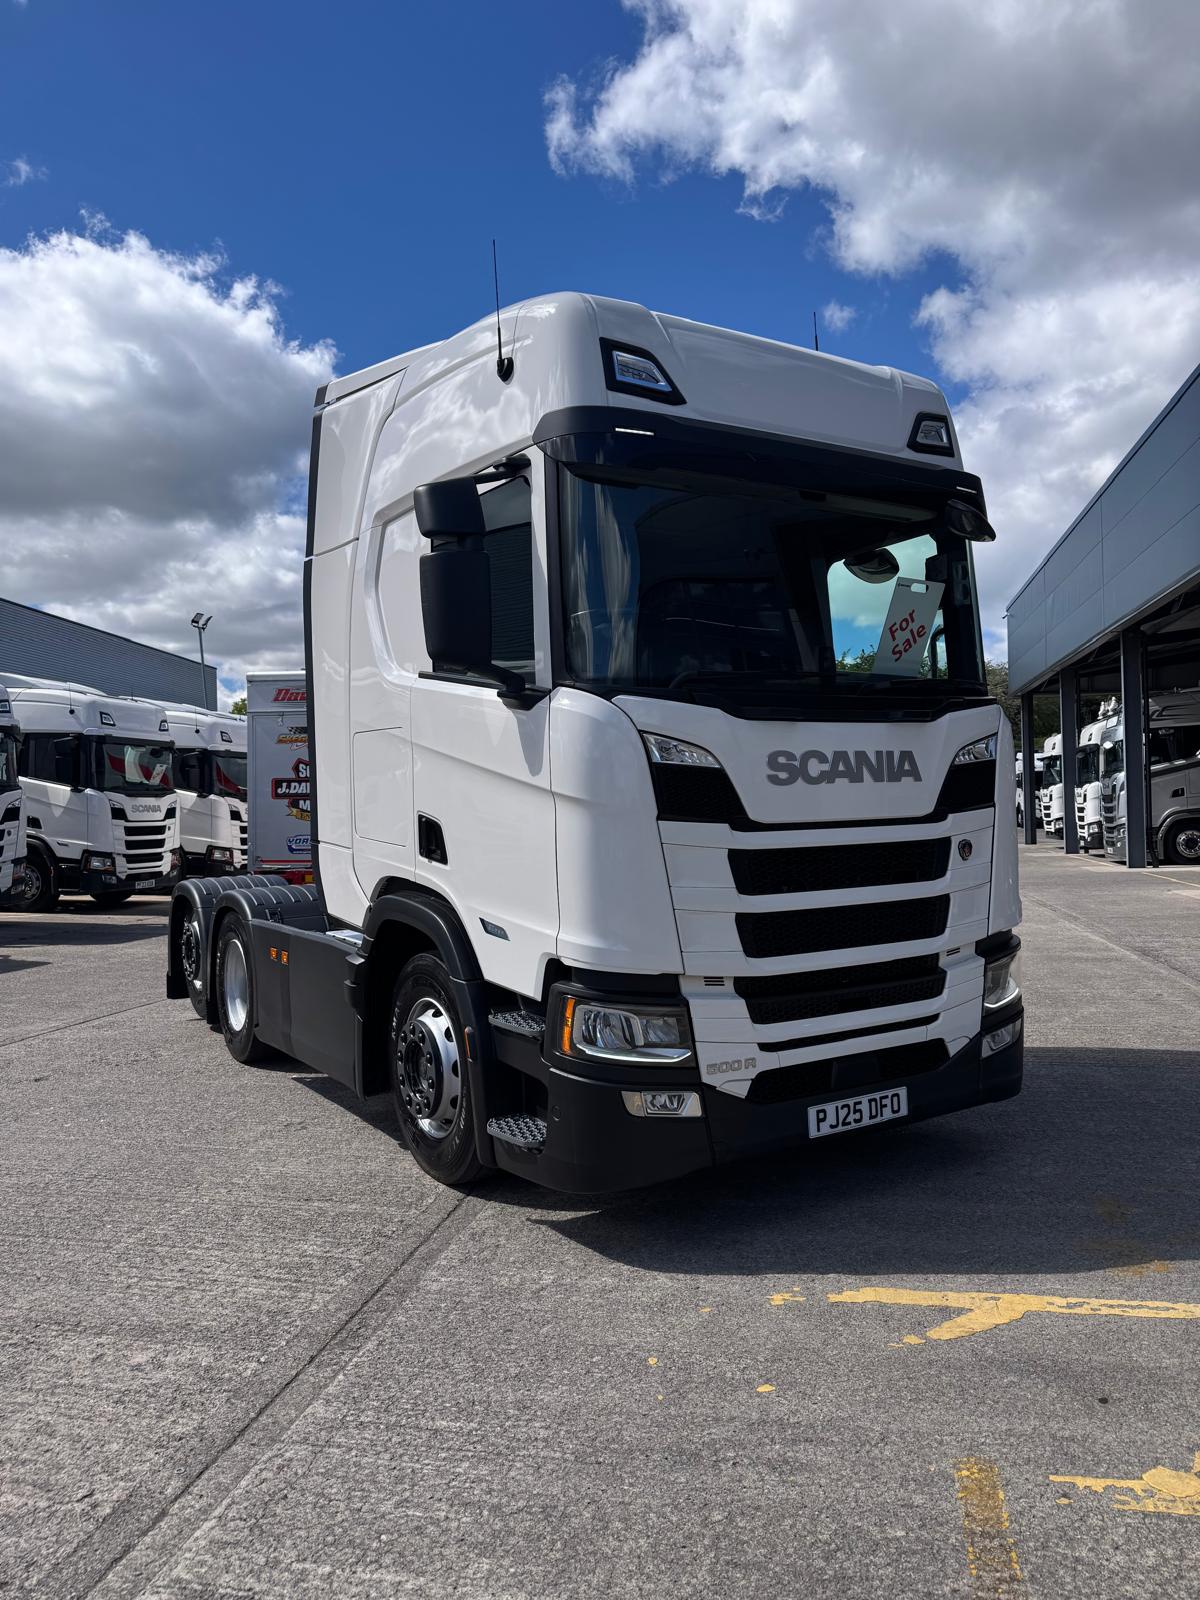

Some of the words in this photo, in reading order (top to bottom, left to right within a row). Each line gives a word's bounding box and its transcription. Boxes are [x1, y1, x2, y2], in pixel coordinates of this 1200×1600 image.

[889, 609, 915, 641] For
[891, 624, 927, 662] Sale
[766, 750, 922, 786] SCANIA
[131, 804, 161, 813] SCANIA
[816, 1101, 863, 1132] PJ25
[868, 1093, 900, 1120] DFO
